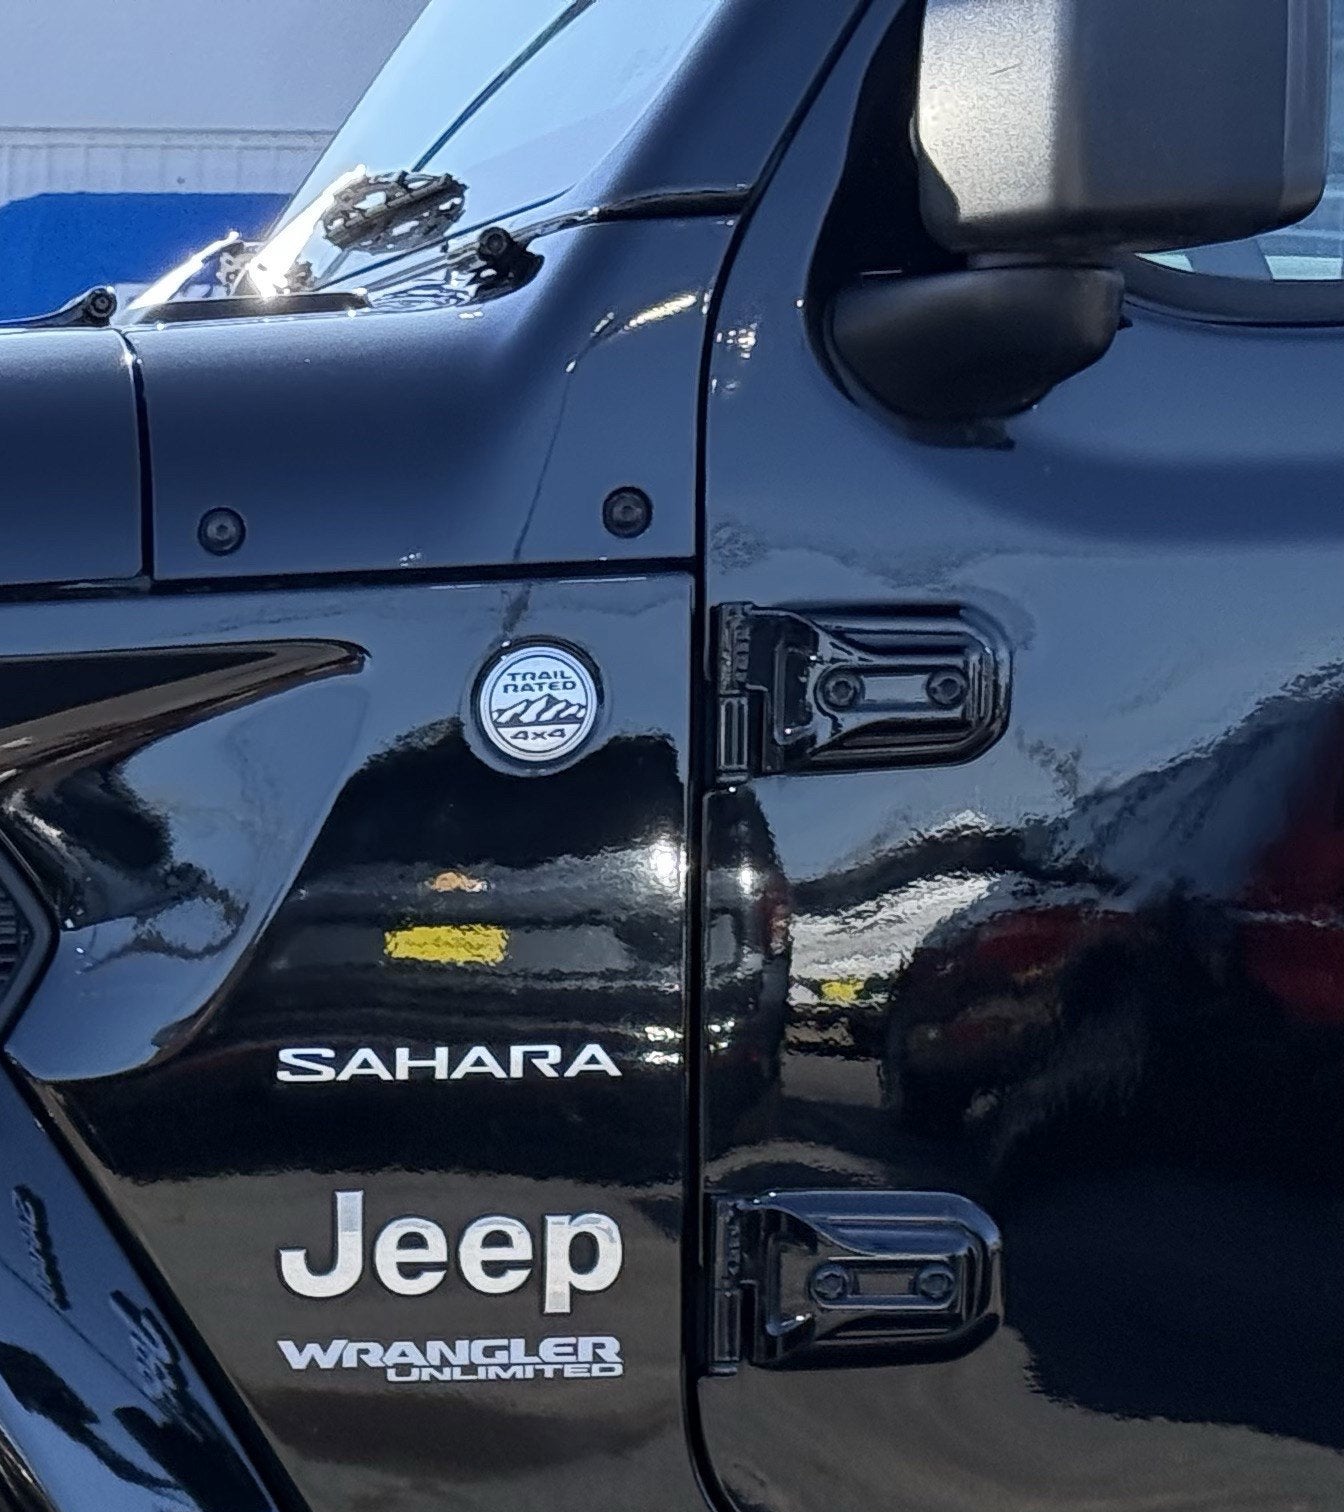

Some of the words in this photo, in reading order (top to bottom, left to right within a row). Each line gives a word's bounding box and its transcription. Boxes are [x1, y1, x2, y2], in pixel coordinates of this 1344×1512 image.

[503, 680, 577, 693] RATED
[507, 670, 572, 682] TRAIL
[276, 1043, 623, 1082] SAHARA
[278, 1189, 624, 1314] Jeep
[276, 1335, 624, 1370] WRANGLER
[385, 1363, 624, 1382] UNLIMITED
